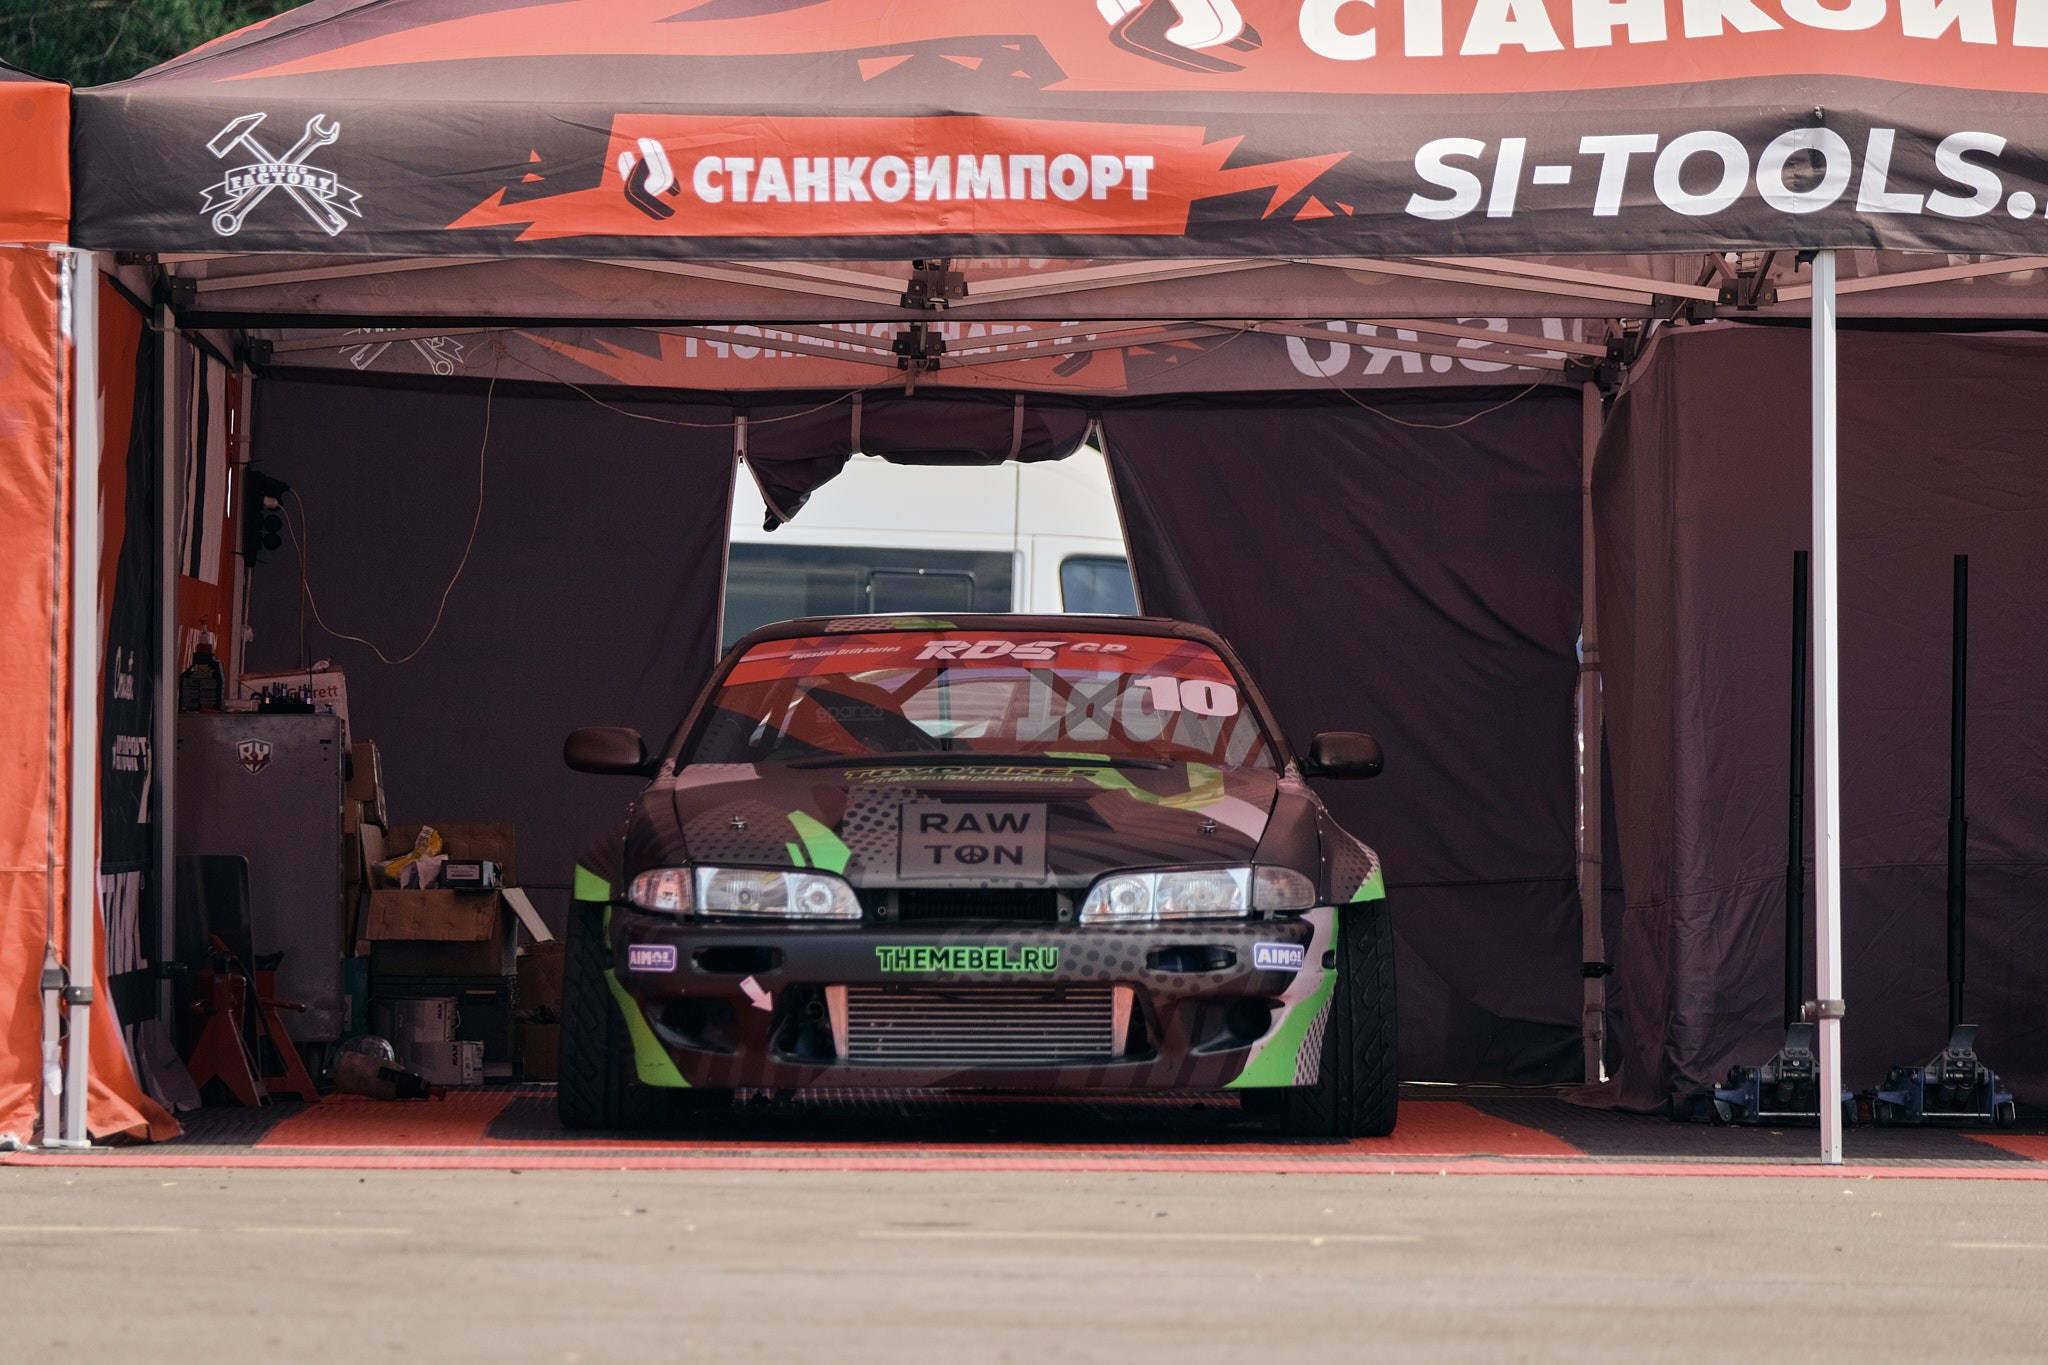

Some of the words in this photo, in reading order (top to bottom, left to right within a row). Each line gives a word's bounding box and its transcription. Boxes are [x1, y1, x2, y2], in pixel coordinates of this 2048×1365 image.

[1298, 0, 2048, 61] СТАНКОИ
[247, 165, 307, 175] TUNING
[692, 152, 1155, 203] СТАНКОИМПОРТ
[1404, 127, 2048, 221] SI-TOOLS.
[230, 172, 332, 190] FACTORY
[915, 640, 1069, 660] RDS
[1069, 642, 1129, 653] GP
[1134, 675, 1239, 717] 10
[920, 813, 1031, 833] RAW
[924, 845, 1023, 865] TON
[630, 950, 673, 966] AIMOL
[876, 946, 1060, 973] THEMEBEL.RU
[1257, 949, 1303, 965] AIMOL
